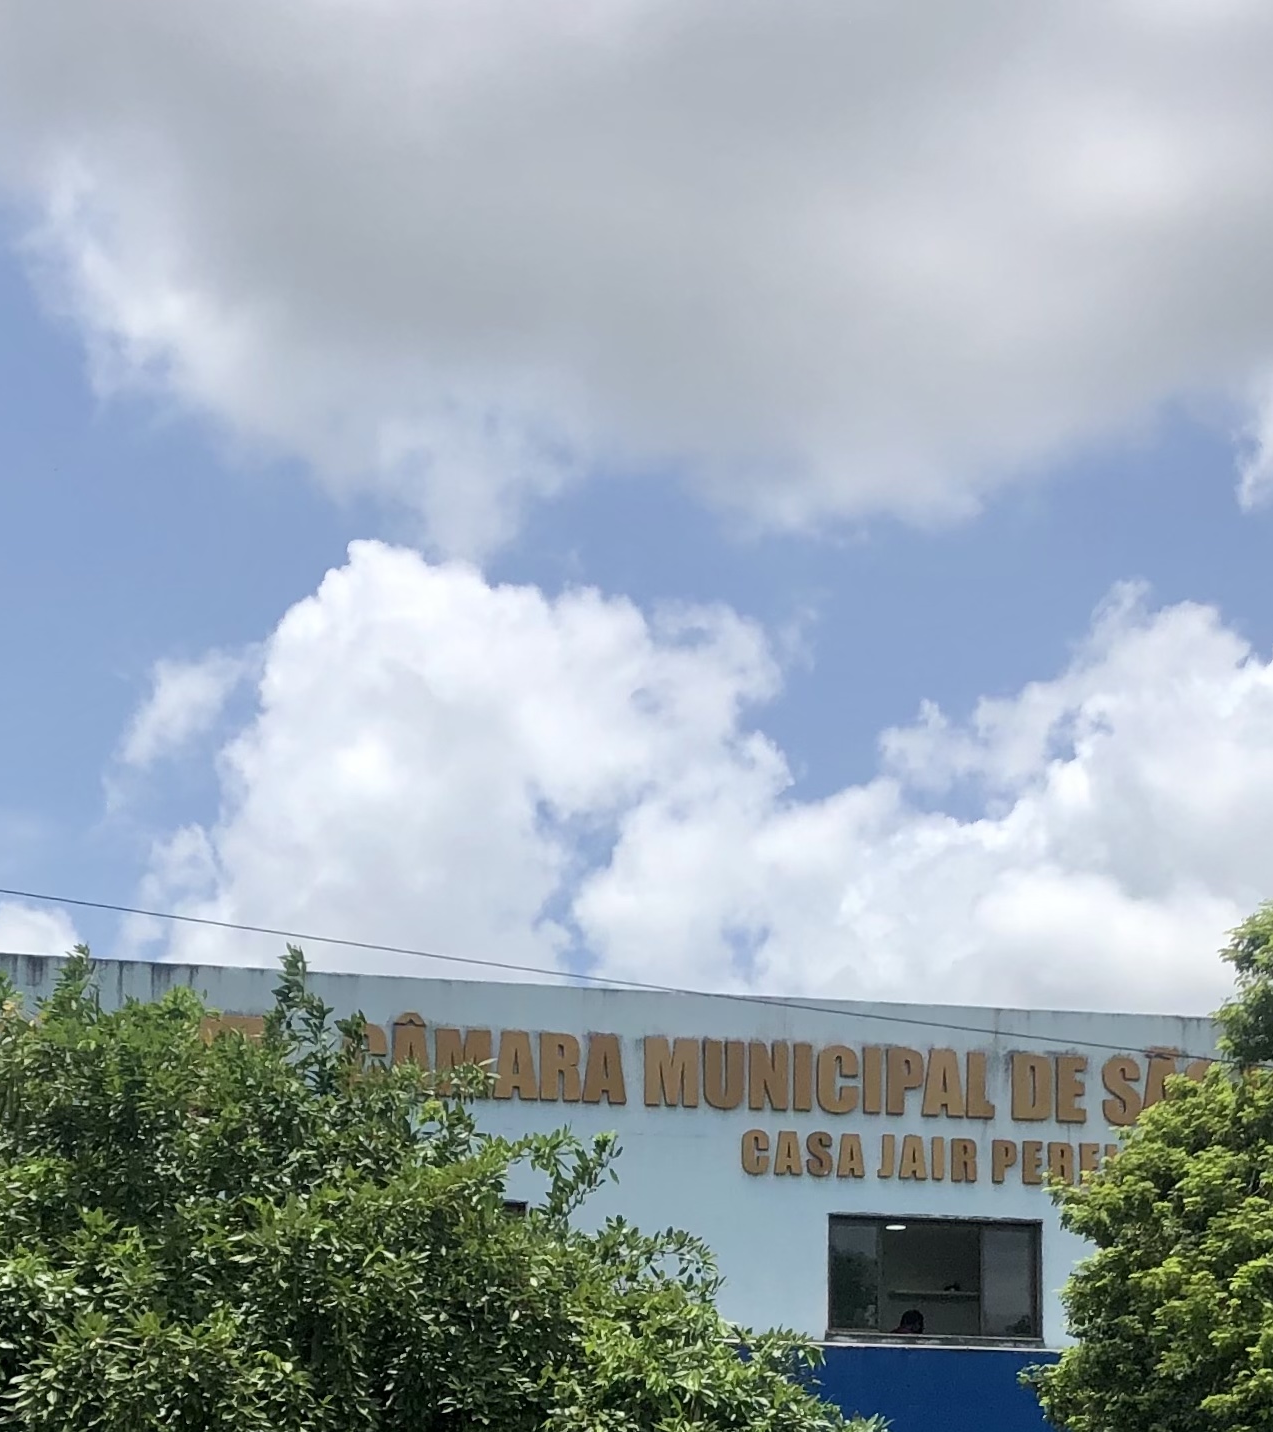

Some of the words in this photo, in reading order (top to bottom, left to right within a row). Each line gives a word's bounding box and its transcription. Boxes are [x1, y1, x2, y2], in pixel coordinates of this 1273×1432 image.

[643, 1034, 996, 1121] MUNICIPAL
[1011, 1051, 1088, 1124] DE
[1101, 1046, 1213, 1126] SÃ
[740, 1129, 866, 1178] CASA
[877, 1134, 978, 1183] JAIR
